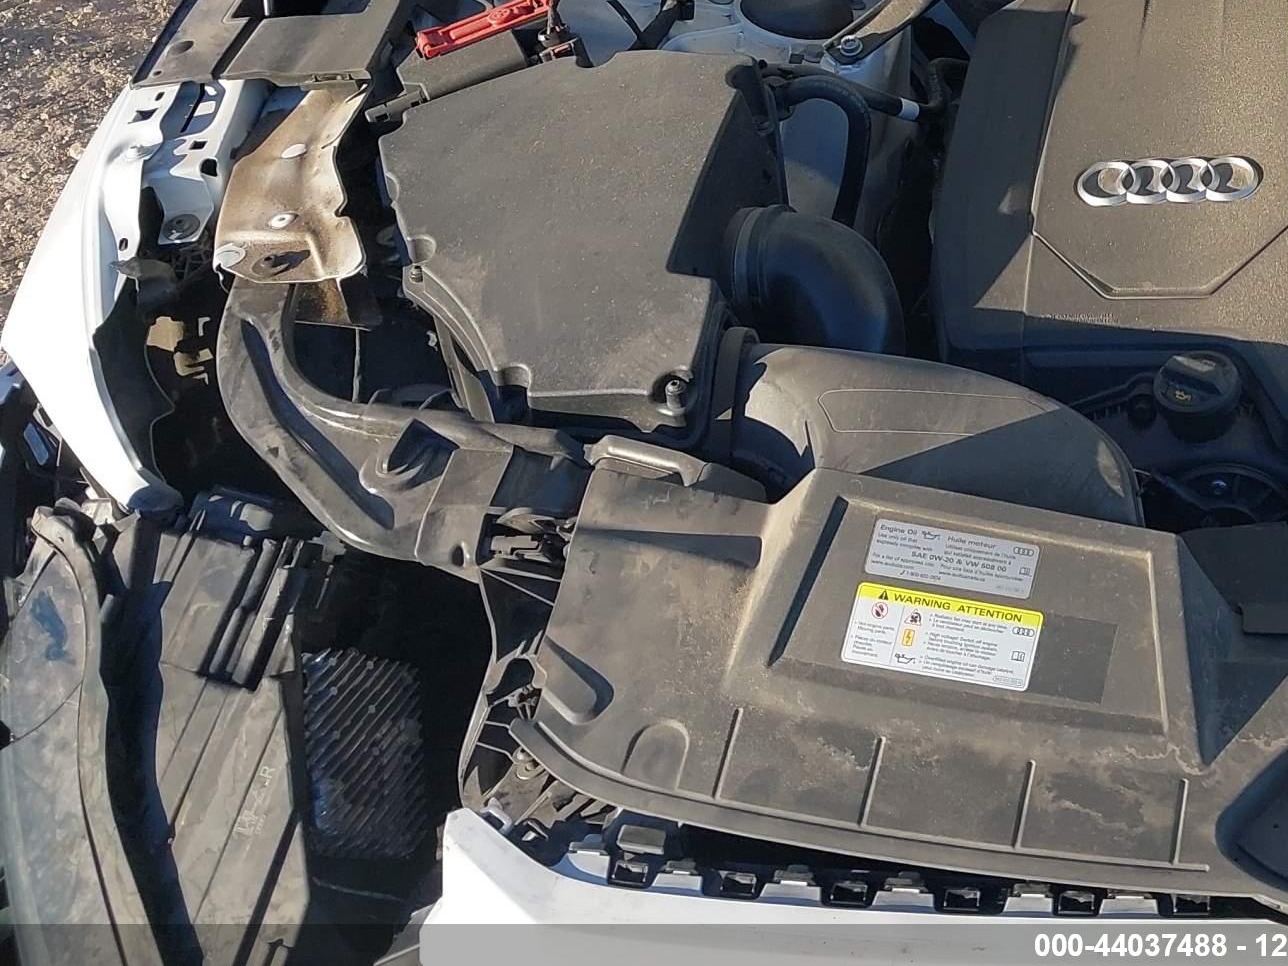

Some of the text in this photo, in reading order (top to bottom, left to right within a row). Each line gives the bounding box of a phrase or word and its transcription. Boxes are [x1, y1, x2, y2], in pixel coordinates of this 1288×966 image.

[880, 524, 905, 534] Engine
[947, 535, 996, 549] Huile moteur
[894, 593, 1022, 622] WARNING ATTENTION
